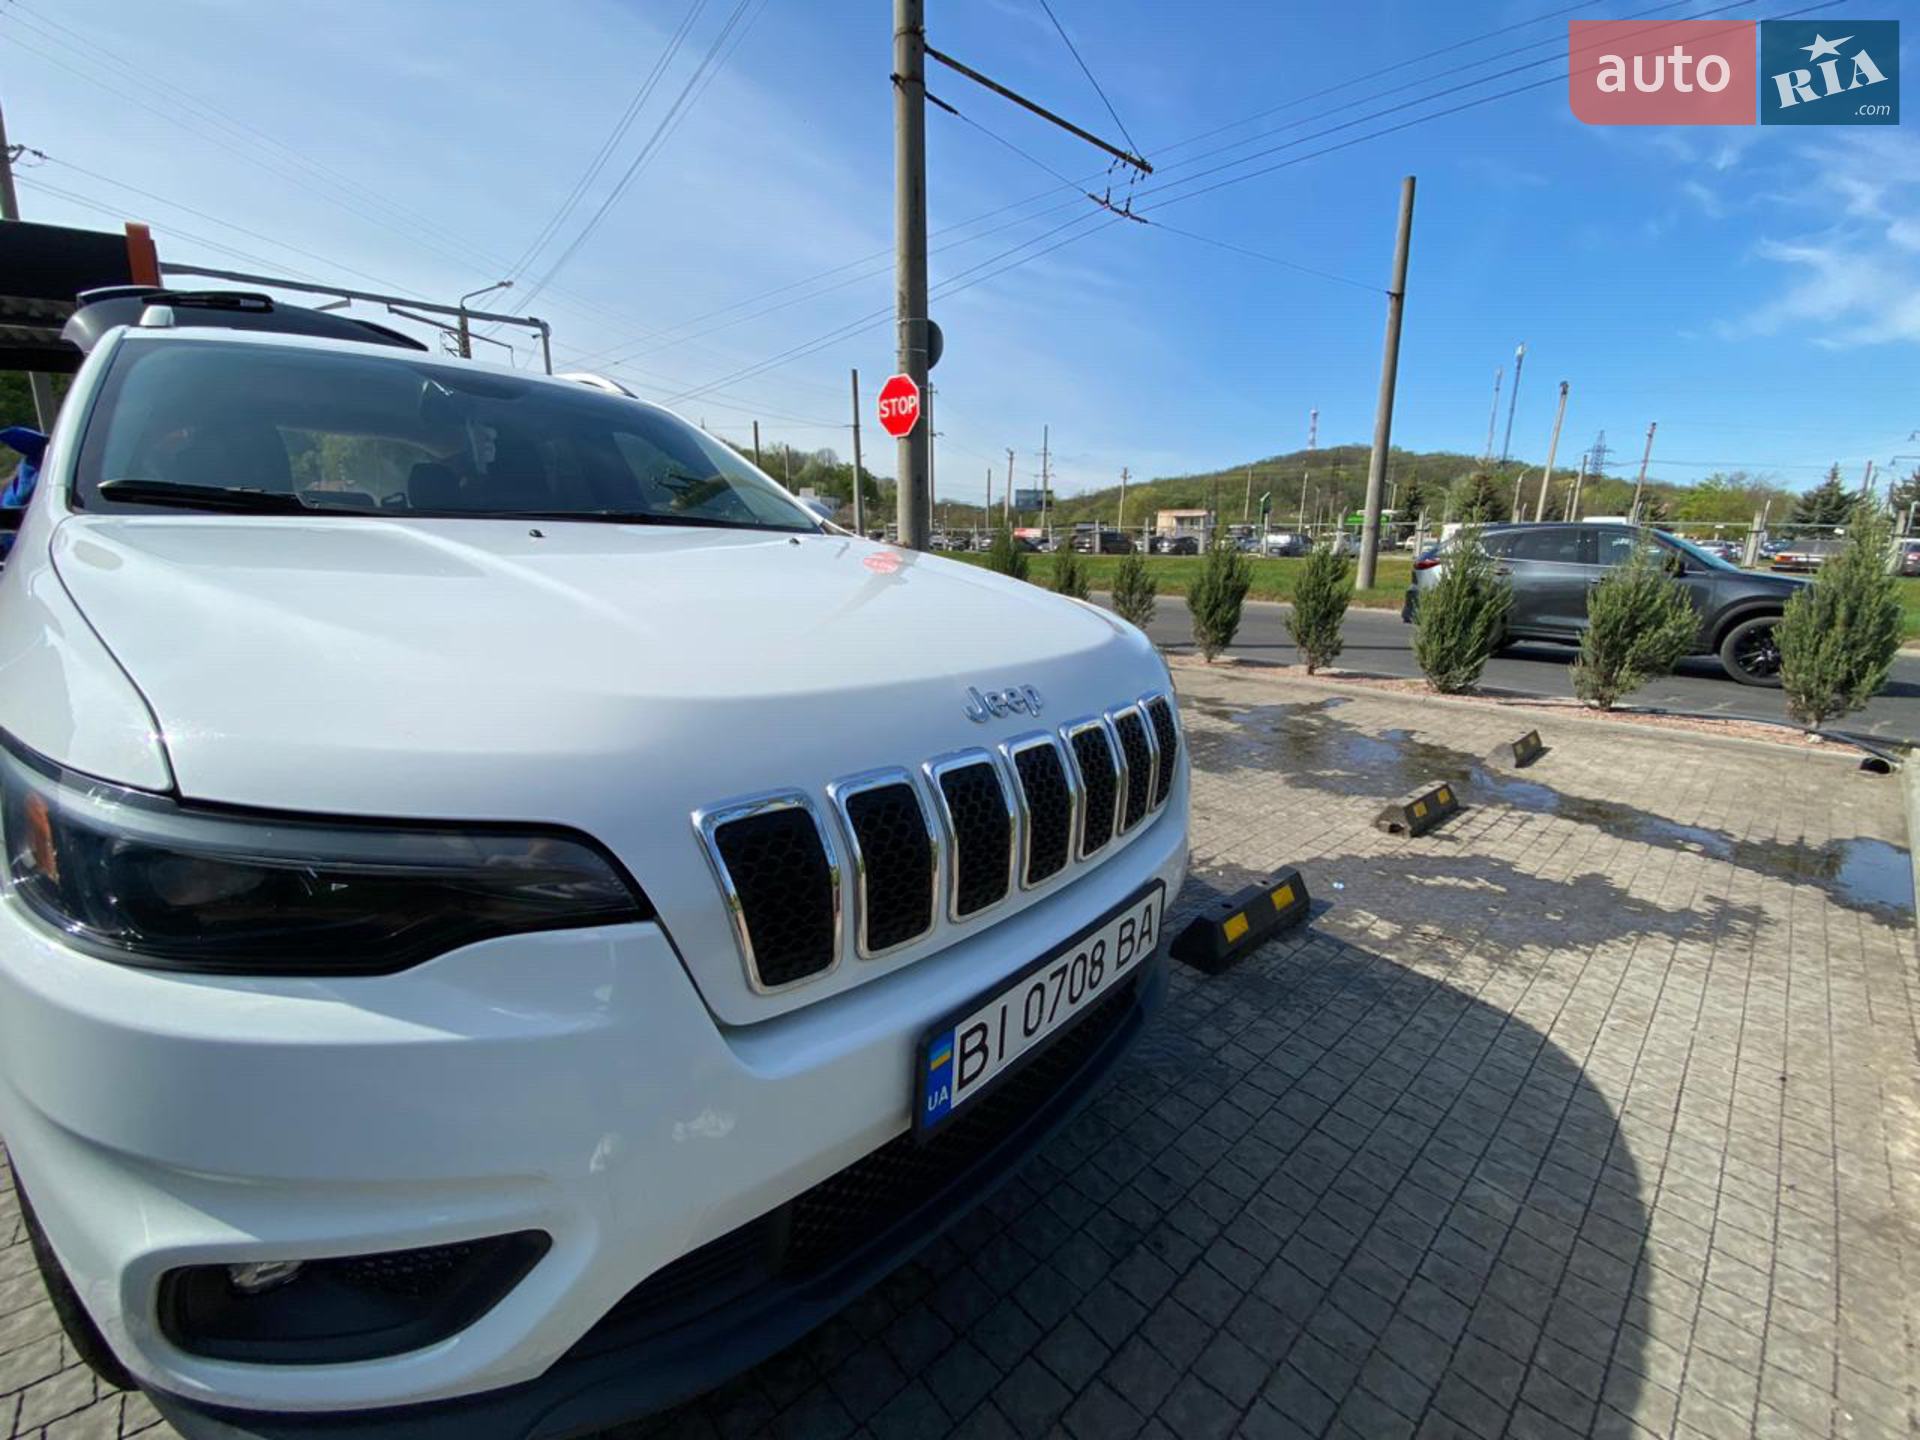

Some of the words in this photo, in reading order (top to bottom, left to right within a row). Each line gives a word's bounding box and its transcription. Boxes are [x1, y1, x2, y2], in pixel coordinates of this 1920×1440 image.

[880, 395, 916, 417] STOP
[962, 684, 1042, 723] Jeep
[956, 1003, 1007, 1092] BI
[1023, 939, 1106, 1038] 0708
[1115, 903, 1153, 970] BA
[927, 1085, 949, 1111] UA
